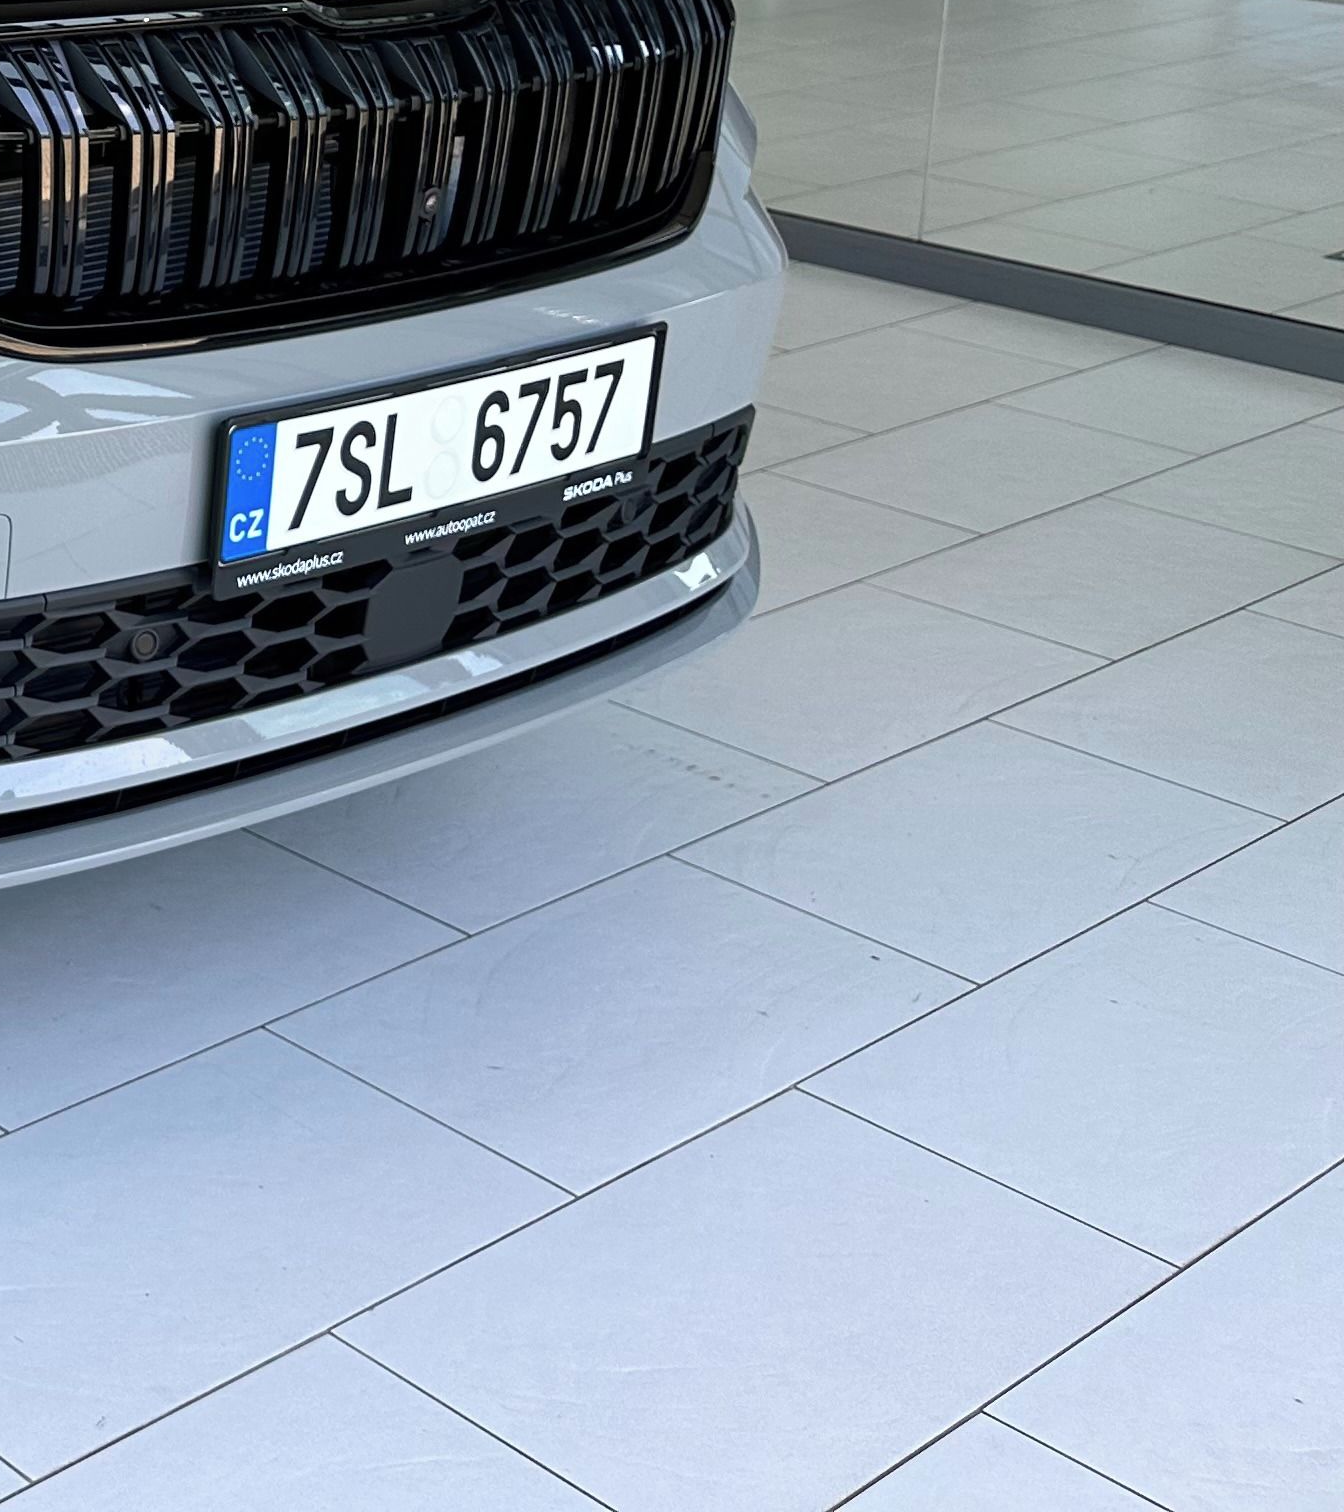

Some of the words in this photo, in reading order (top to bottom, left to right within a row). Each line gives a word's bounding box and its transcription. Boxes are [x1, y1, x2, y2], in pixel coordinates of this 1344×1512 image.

[287, 412, 413, 531] 7SL
[470, 358, 625, 483] 6757
[229, 507, 265, 543] CZ
[404, 510, 497, 546] www.autoopat.cz
[236, 550, 345, 589] www.skodaplus.cz
